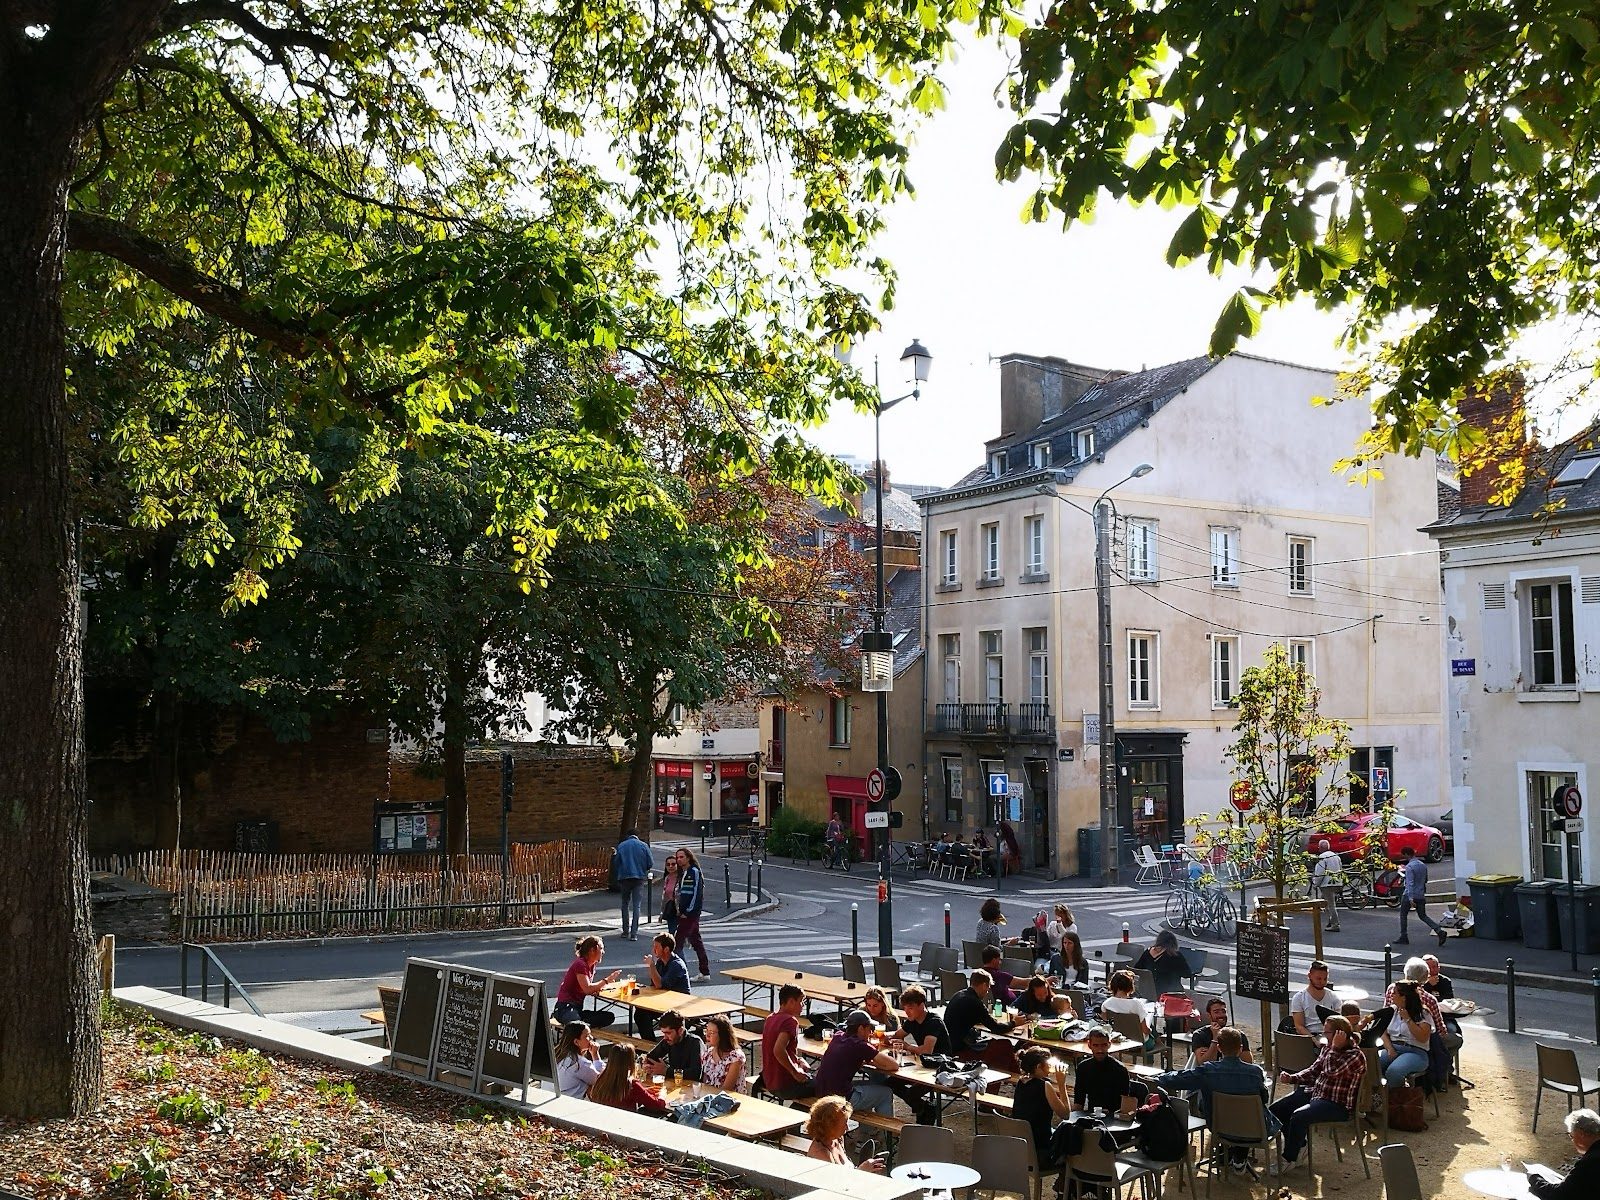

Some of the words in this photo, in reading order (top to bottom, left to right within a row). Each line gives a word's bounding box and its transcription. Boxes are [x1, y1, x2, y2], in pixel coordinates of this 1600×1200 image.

[496, 993, 526, 1011] TERRASSE
[502, 1013, 512, 1025] DU
[497, 1024, 519, 1040] VIEUX
